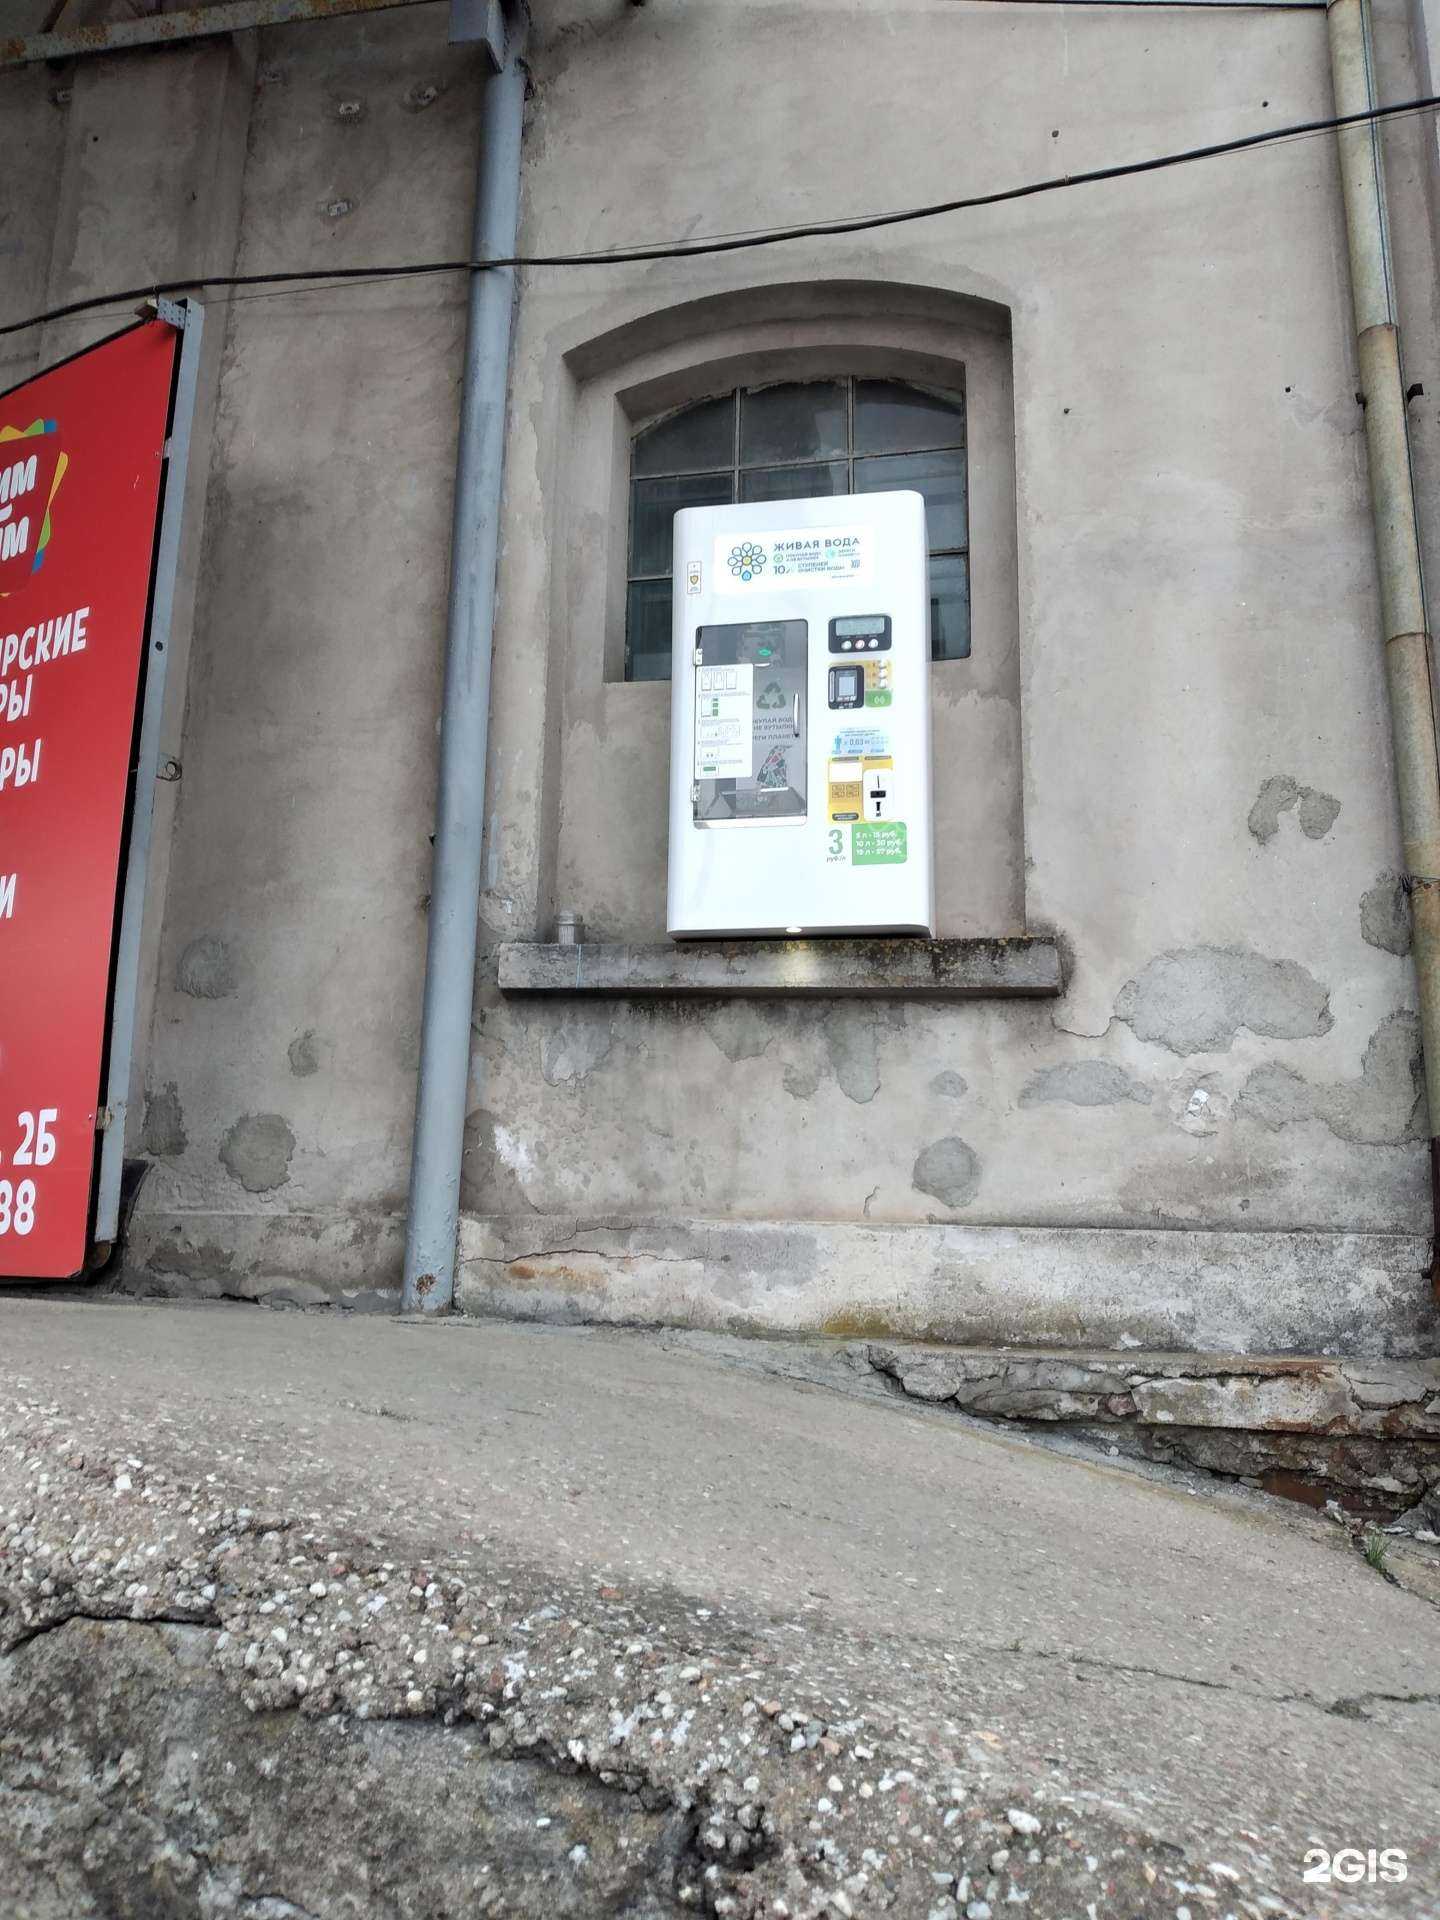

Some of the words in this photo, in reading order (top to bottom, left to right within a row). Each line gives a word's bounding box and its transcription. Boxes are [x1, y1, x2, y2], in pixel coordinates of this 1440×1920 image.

[774, 540, 820, 552] ЖИВАЯ
[825, 537, 861, 548] ВОДА
[0, 606, 90, 677] РСКИЕ
[828, 829, 844, 855] 3
[13, 1109, 58, 1166] 2Б
